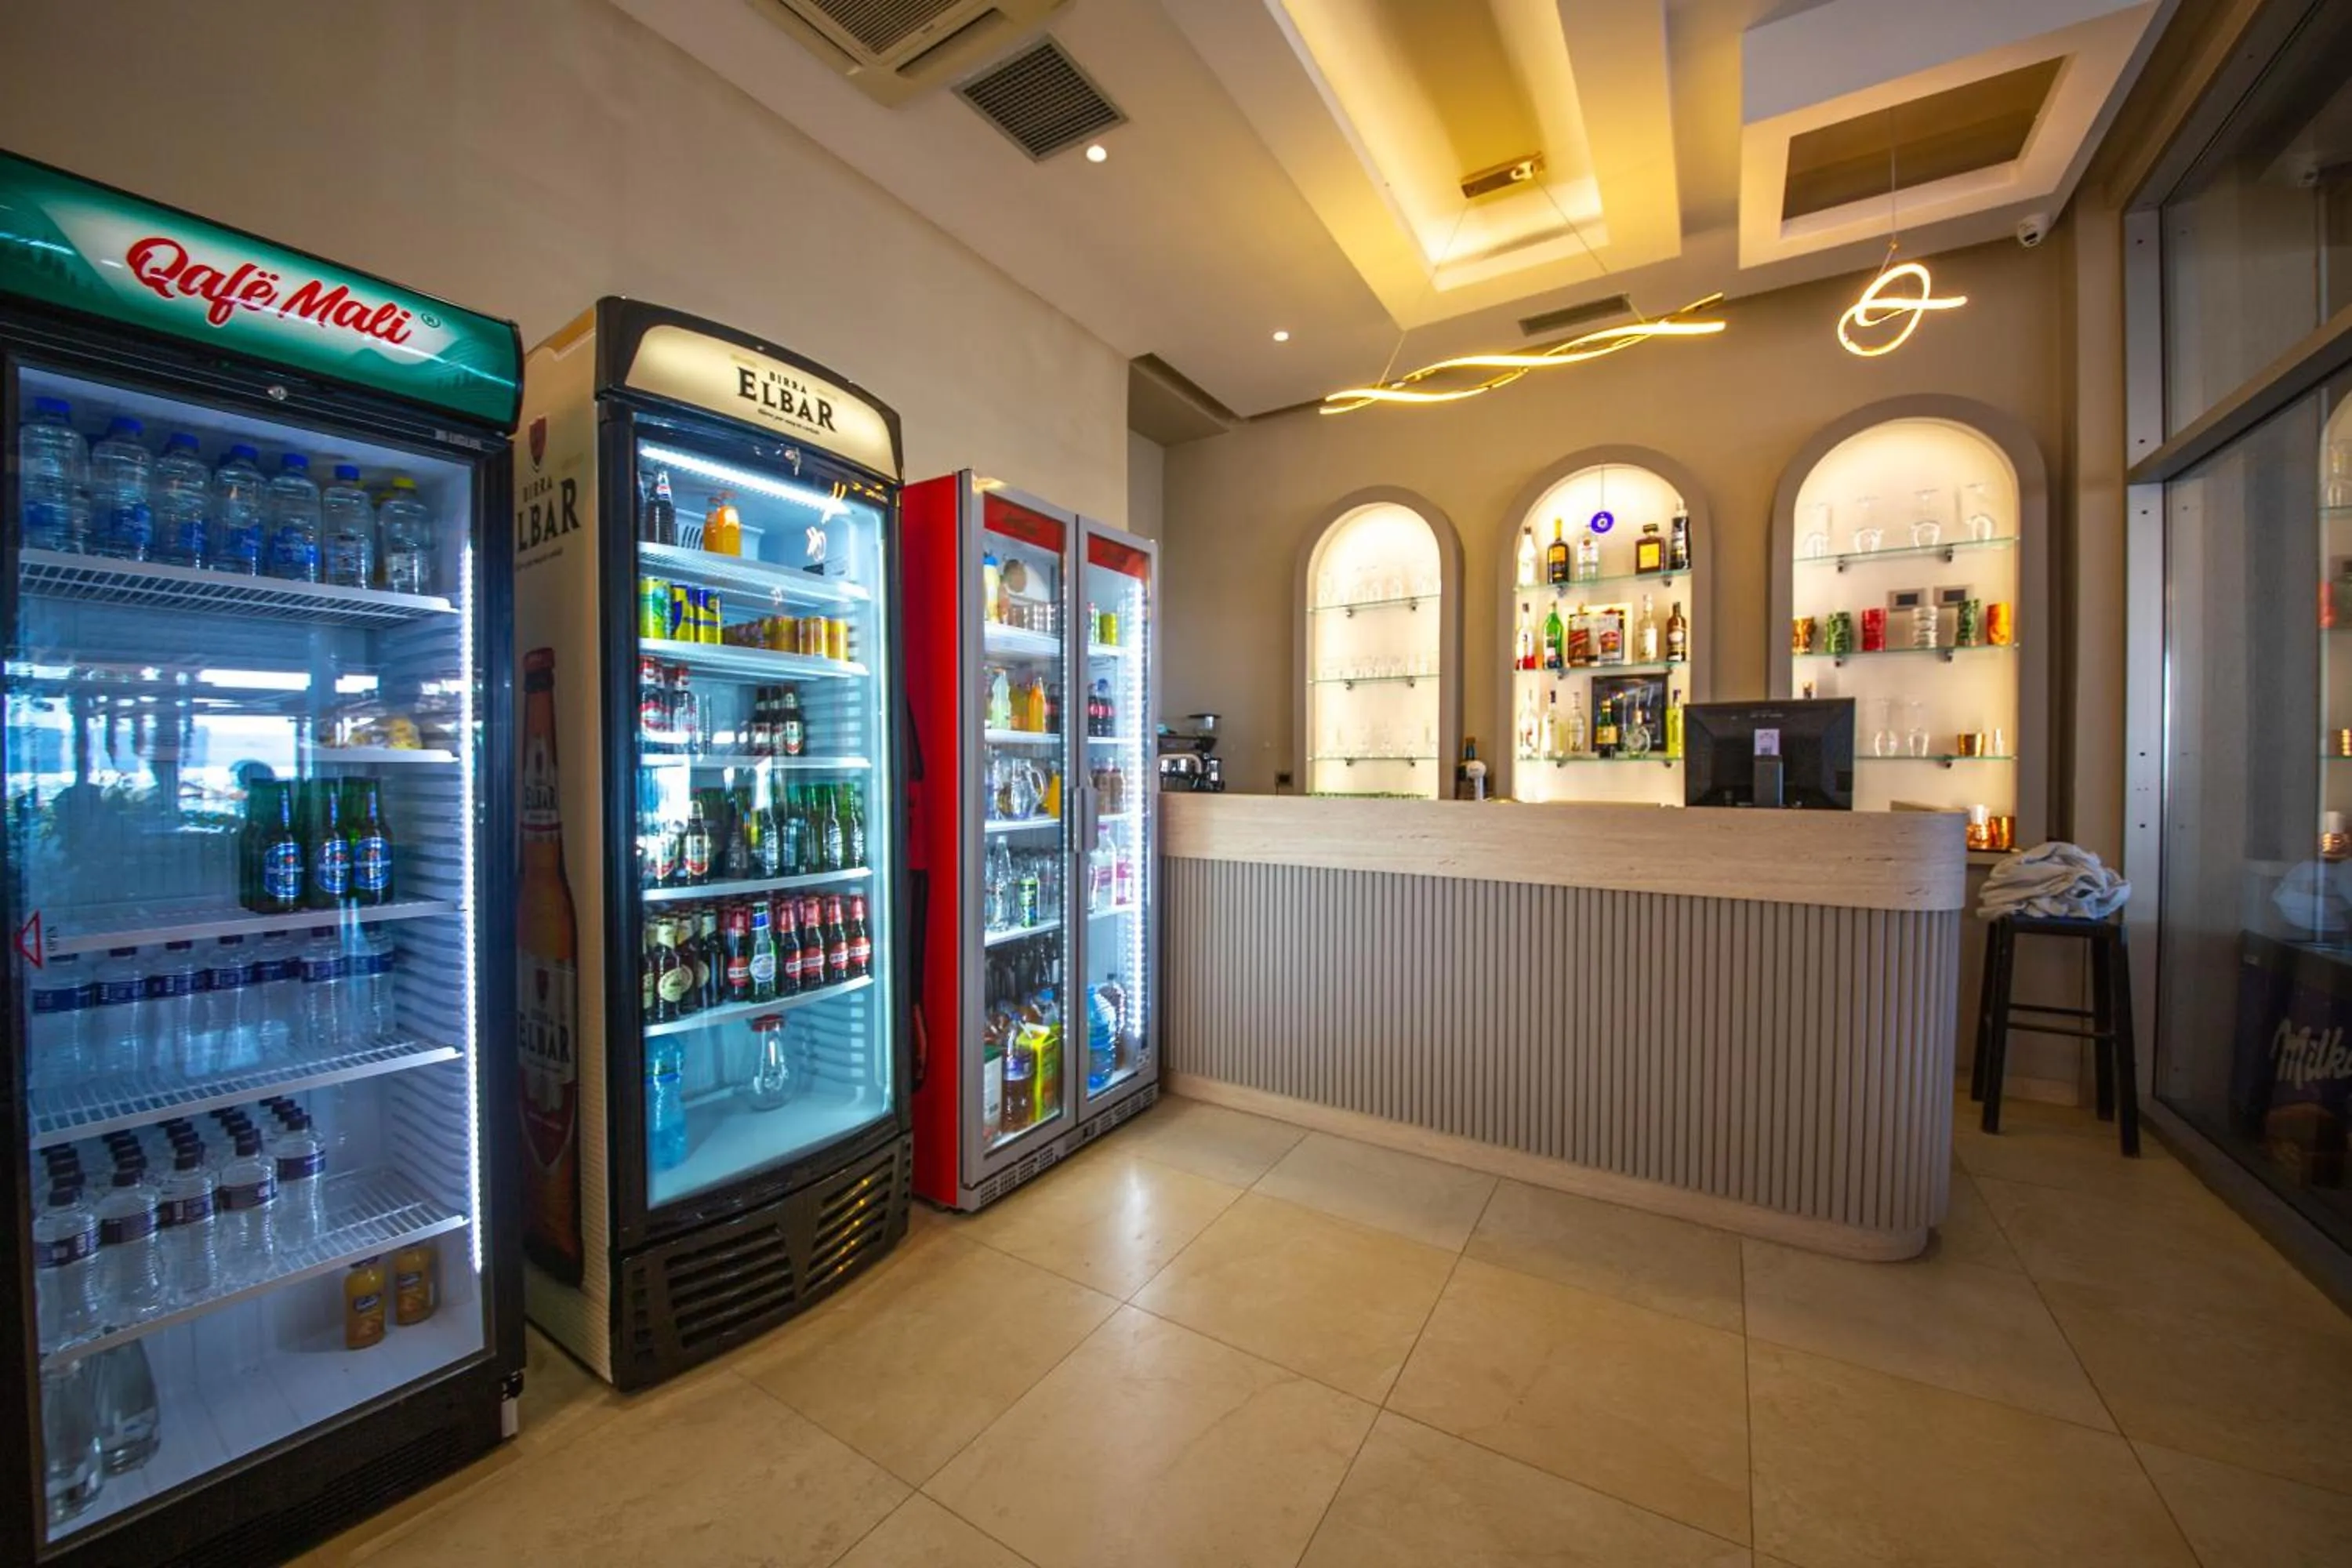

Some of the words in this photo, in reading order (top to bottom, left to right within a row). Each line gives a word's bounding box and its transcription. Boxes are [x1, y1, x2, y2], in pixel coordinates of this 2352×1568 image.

[126, 237, 278, 326] Qafë
[278, 280, 412, 345] Mali
[736, 365, 837, 433] ELBAR
[769, 370, 808, 394] BIRRA
[517, 477, 582, 553] LBAR
